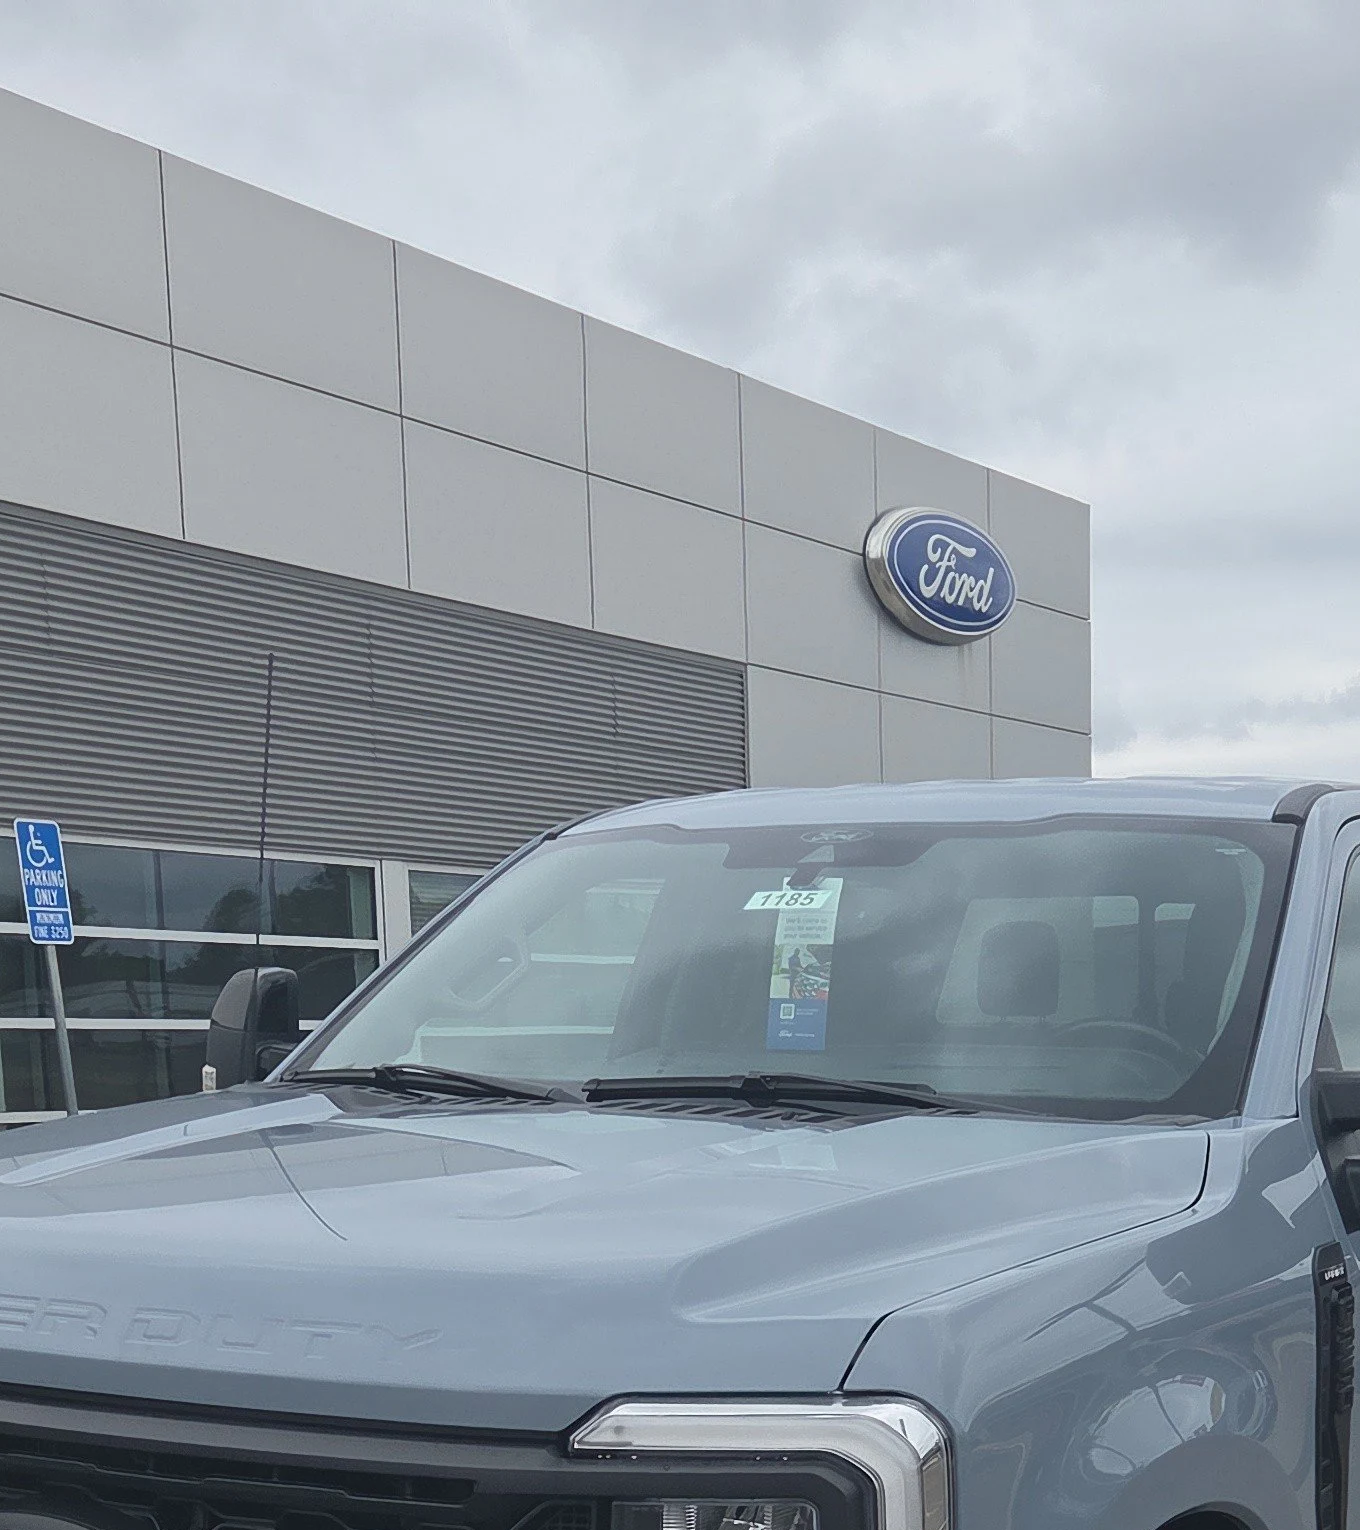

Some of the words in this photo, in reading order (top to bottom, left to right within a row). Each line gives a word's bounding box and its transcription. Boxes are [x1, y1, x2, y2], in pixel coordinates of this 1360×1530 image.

[919, 534, 994, 613] Ford
[23, 868, 64, 888] PARKING
[34, 888, 58, 906] ONLY
[760, 892, 818, 907] 1185
[124, 1306, 444, 1366] DUTY
